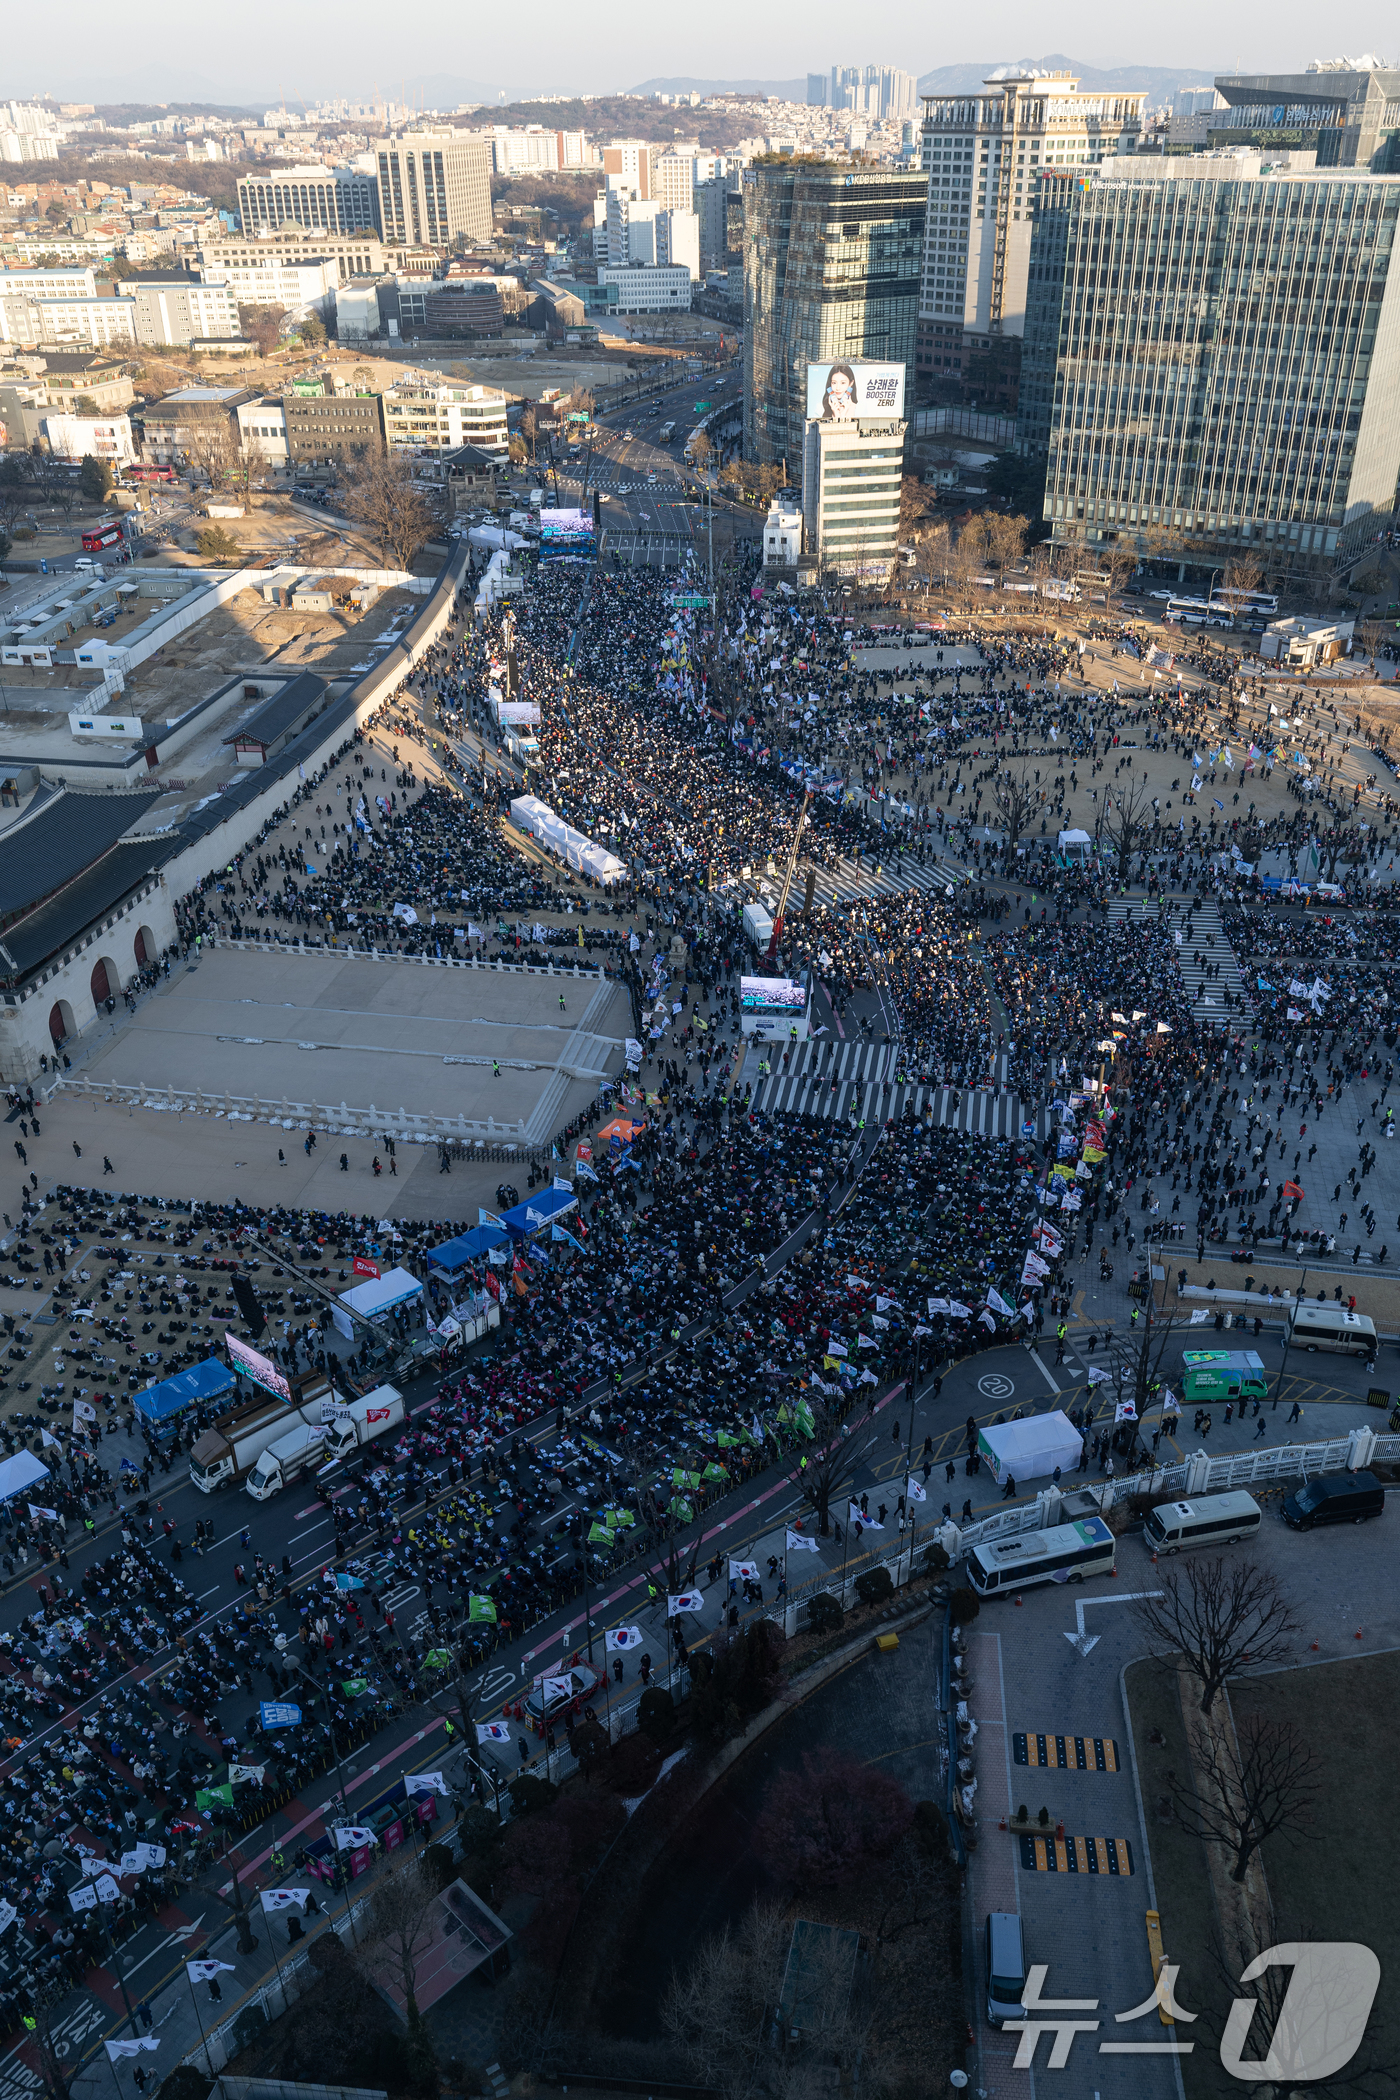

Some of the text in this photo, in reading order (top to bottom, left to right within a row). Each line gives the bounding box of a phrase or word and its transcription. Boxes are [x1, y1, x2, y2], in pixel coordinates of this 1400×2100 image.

[1051, 103, 1100, 116] SOMERSET
[854, 173, 892, 185] KDB산업은행
[1090, 180, 1127, 190] Microsoft
[866, 379, 898, 391] 상쾌환
[866, 391, 896, 399] BOOSTER
[877, 399, 895, 407] ZERO
[983, 1378, 1009, 1395] 20
